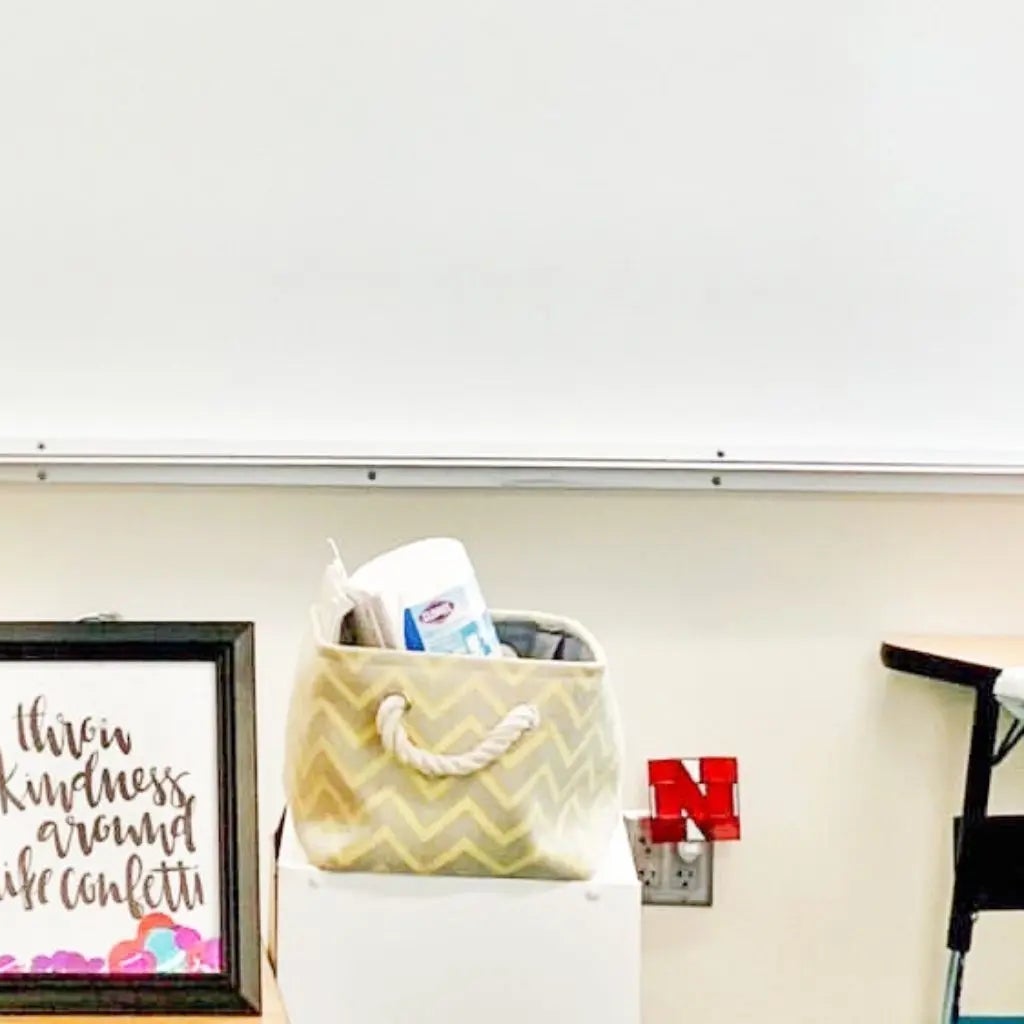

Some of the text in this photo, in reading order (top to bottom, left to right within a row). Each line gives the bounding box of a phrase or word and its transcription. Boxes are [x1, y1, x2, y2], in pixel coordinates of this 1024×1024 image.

[11, 694, 133, 760] throw
[36, 795, 197, 859] around
[648, 756, 741, 845] N
[59, 853, 206, 920] confetti
